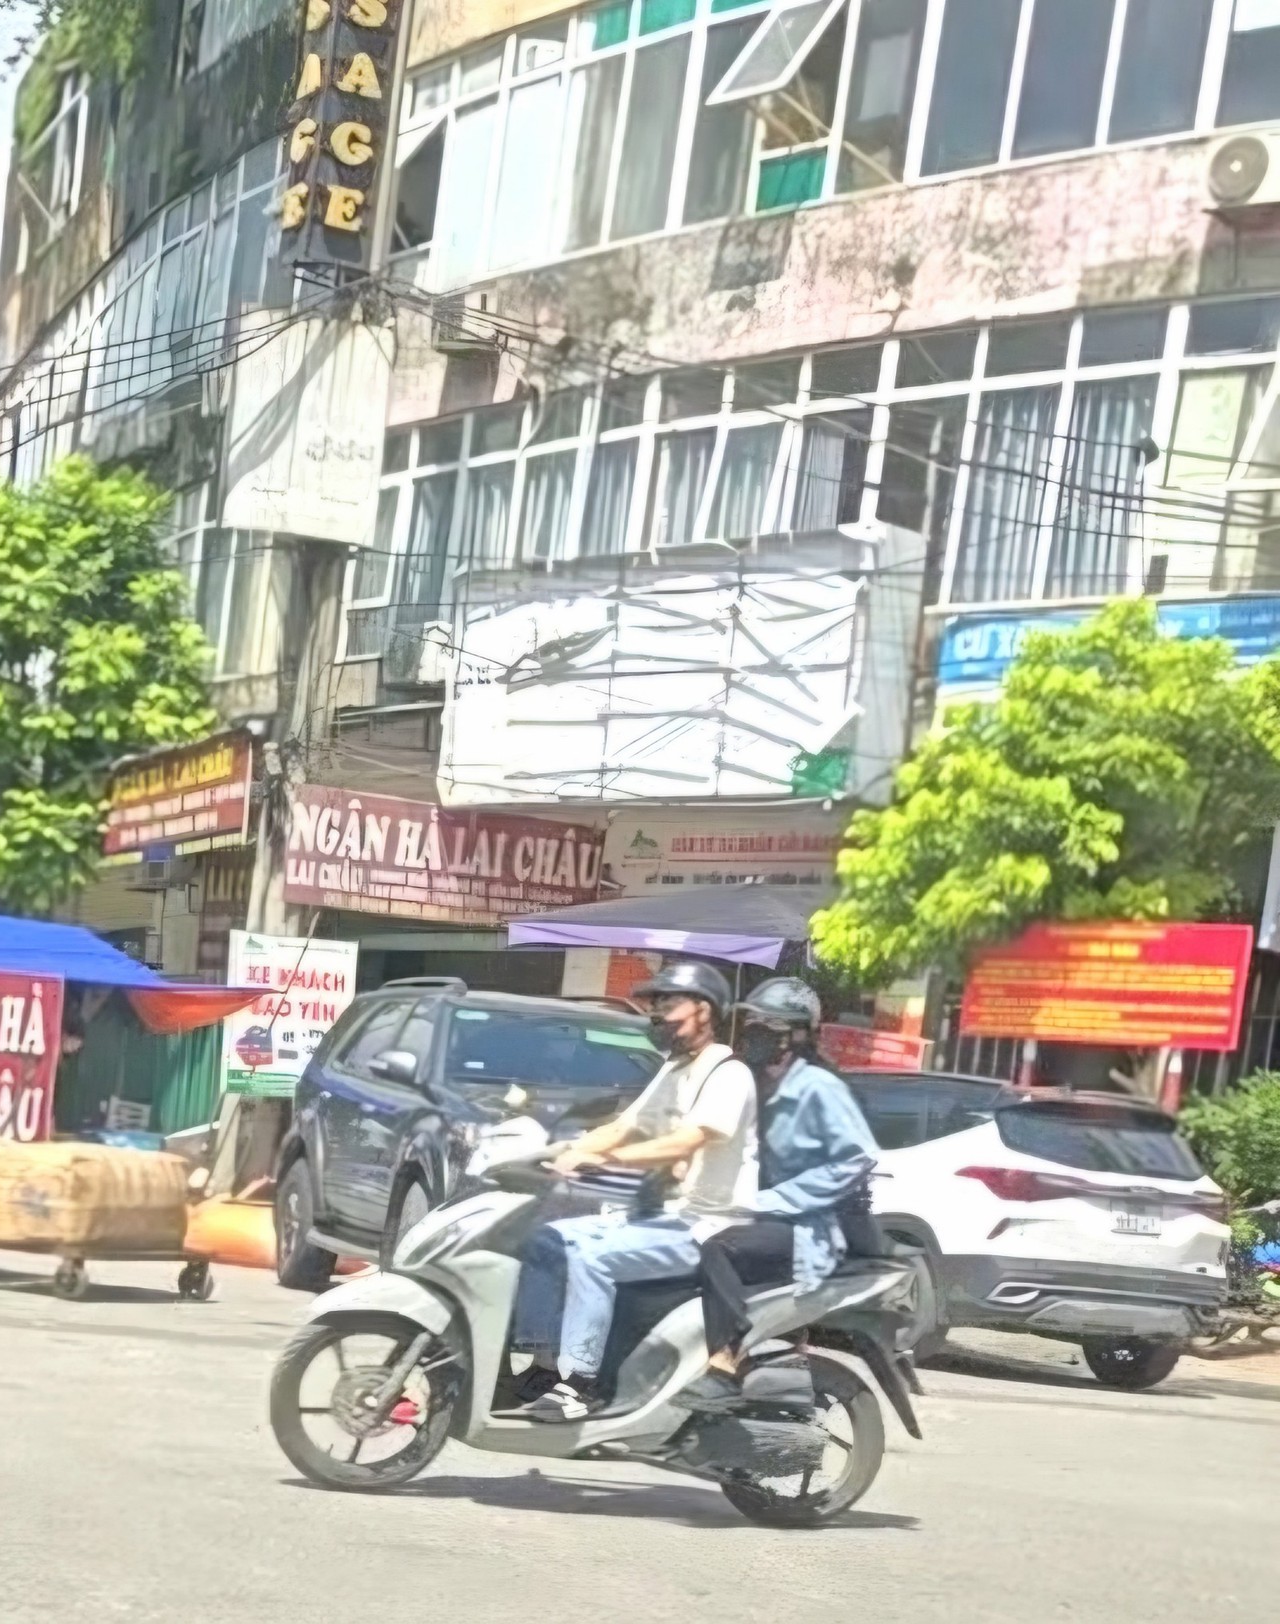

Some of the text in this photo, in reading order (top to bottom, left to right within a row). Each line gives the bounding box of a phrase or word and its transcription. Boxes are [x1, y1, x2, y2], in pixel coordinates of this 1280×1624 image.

[288, 797, 391, 863] NGÂN
[394, 805, 442, 871] HÀ
[447, 825, 511, 878] LAI
[514, 826, 604, 889] CHÂU
